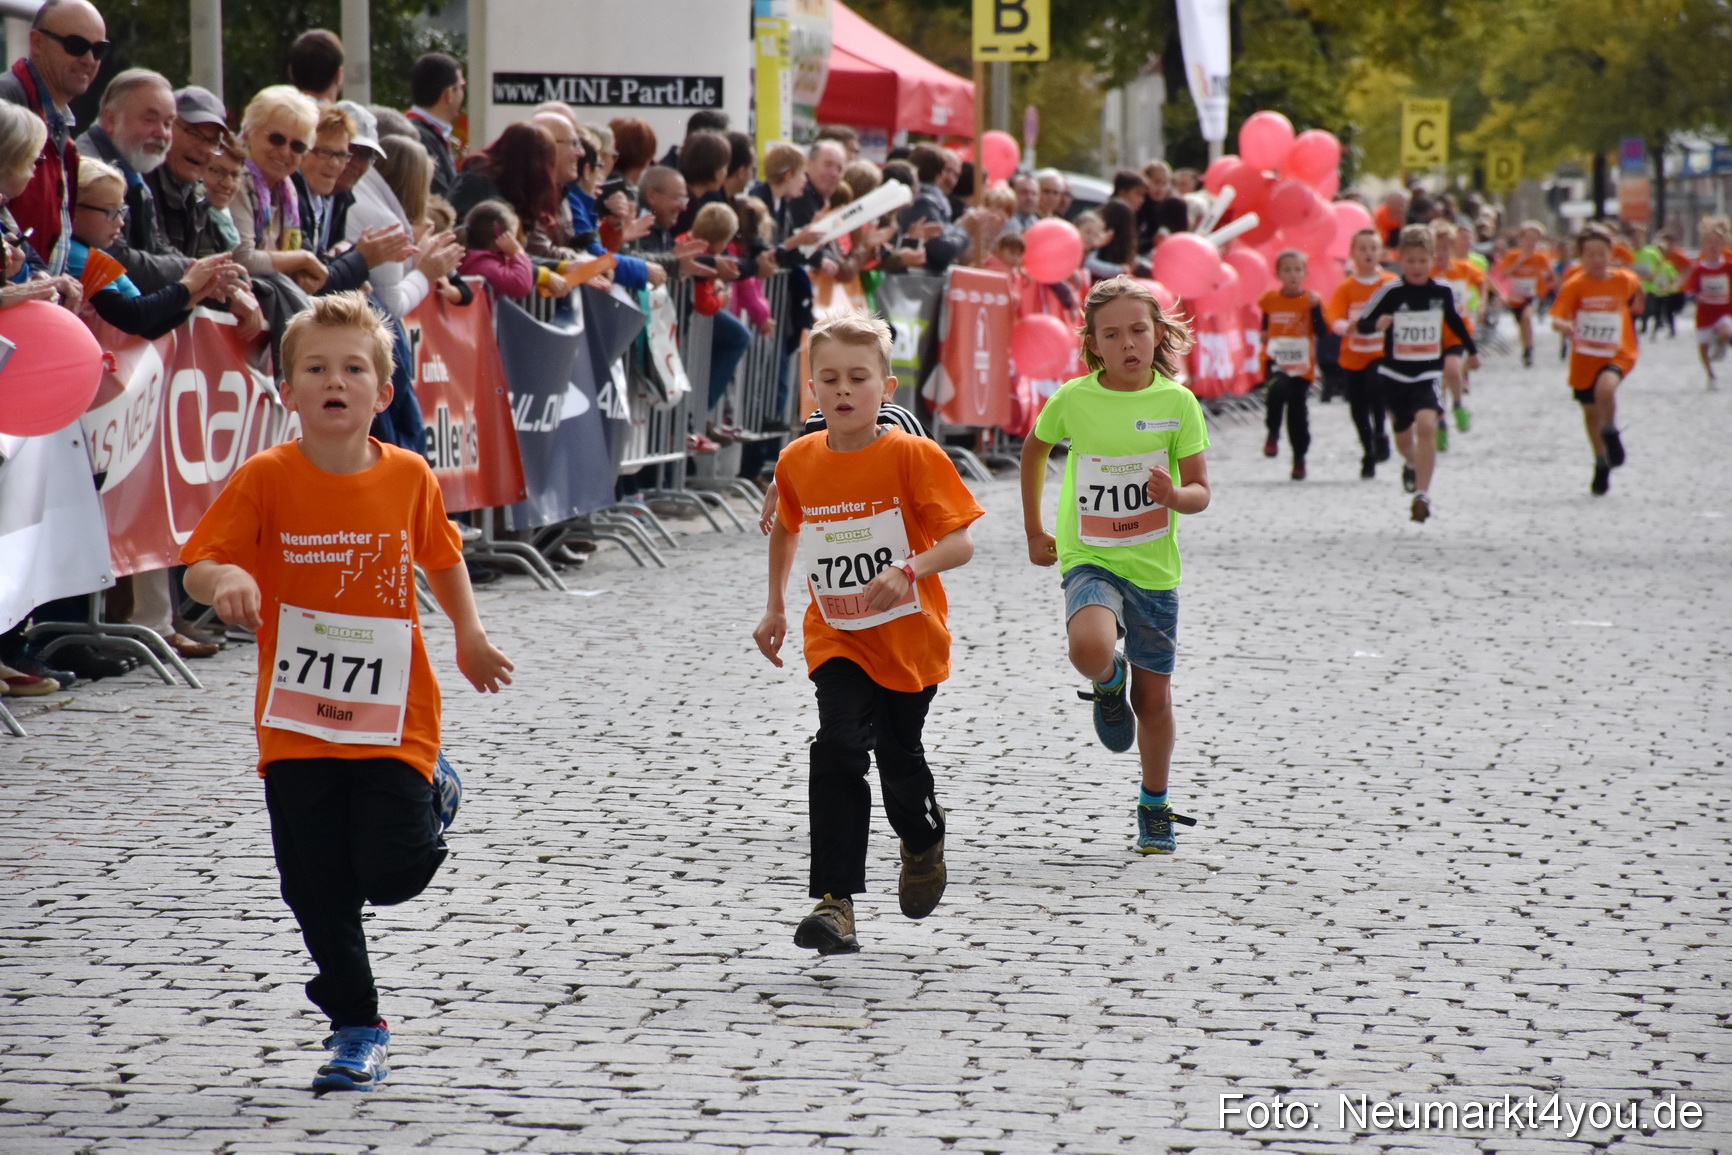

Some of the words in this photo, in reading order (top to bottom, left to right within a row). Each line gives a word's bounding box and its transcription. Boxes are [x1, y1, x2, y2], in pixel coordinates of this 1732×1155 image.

[995, 0, 1028, 33] B
[493, 77, 716, 105] www.MINI-Partl.de
[1413, 120, 1435, 151] C
[1401, 326, 1436, 341] 7013
[1582, 325, 1616, 339] 7177
[1110, 463, 1143, 474] BOCK
[834, 528, 872, 541] BOCK
[1112, 521, 1139, 532] Linus
[280, 531, 373, 546] Neumarkter
[283, 549, 354, 566] Stadtlauf
[398, 530, 410, 608] BAMBINI
[817, 547, 893, 588] 7208
[327, 625, 374, 640] BOCK
[296, 646, 383, 695] 7171
[316, 703, 353, 721] Kilian
